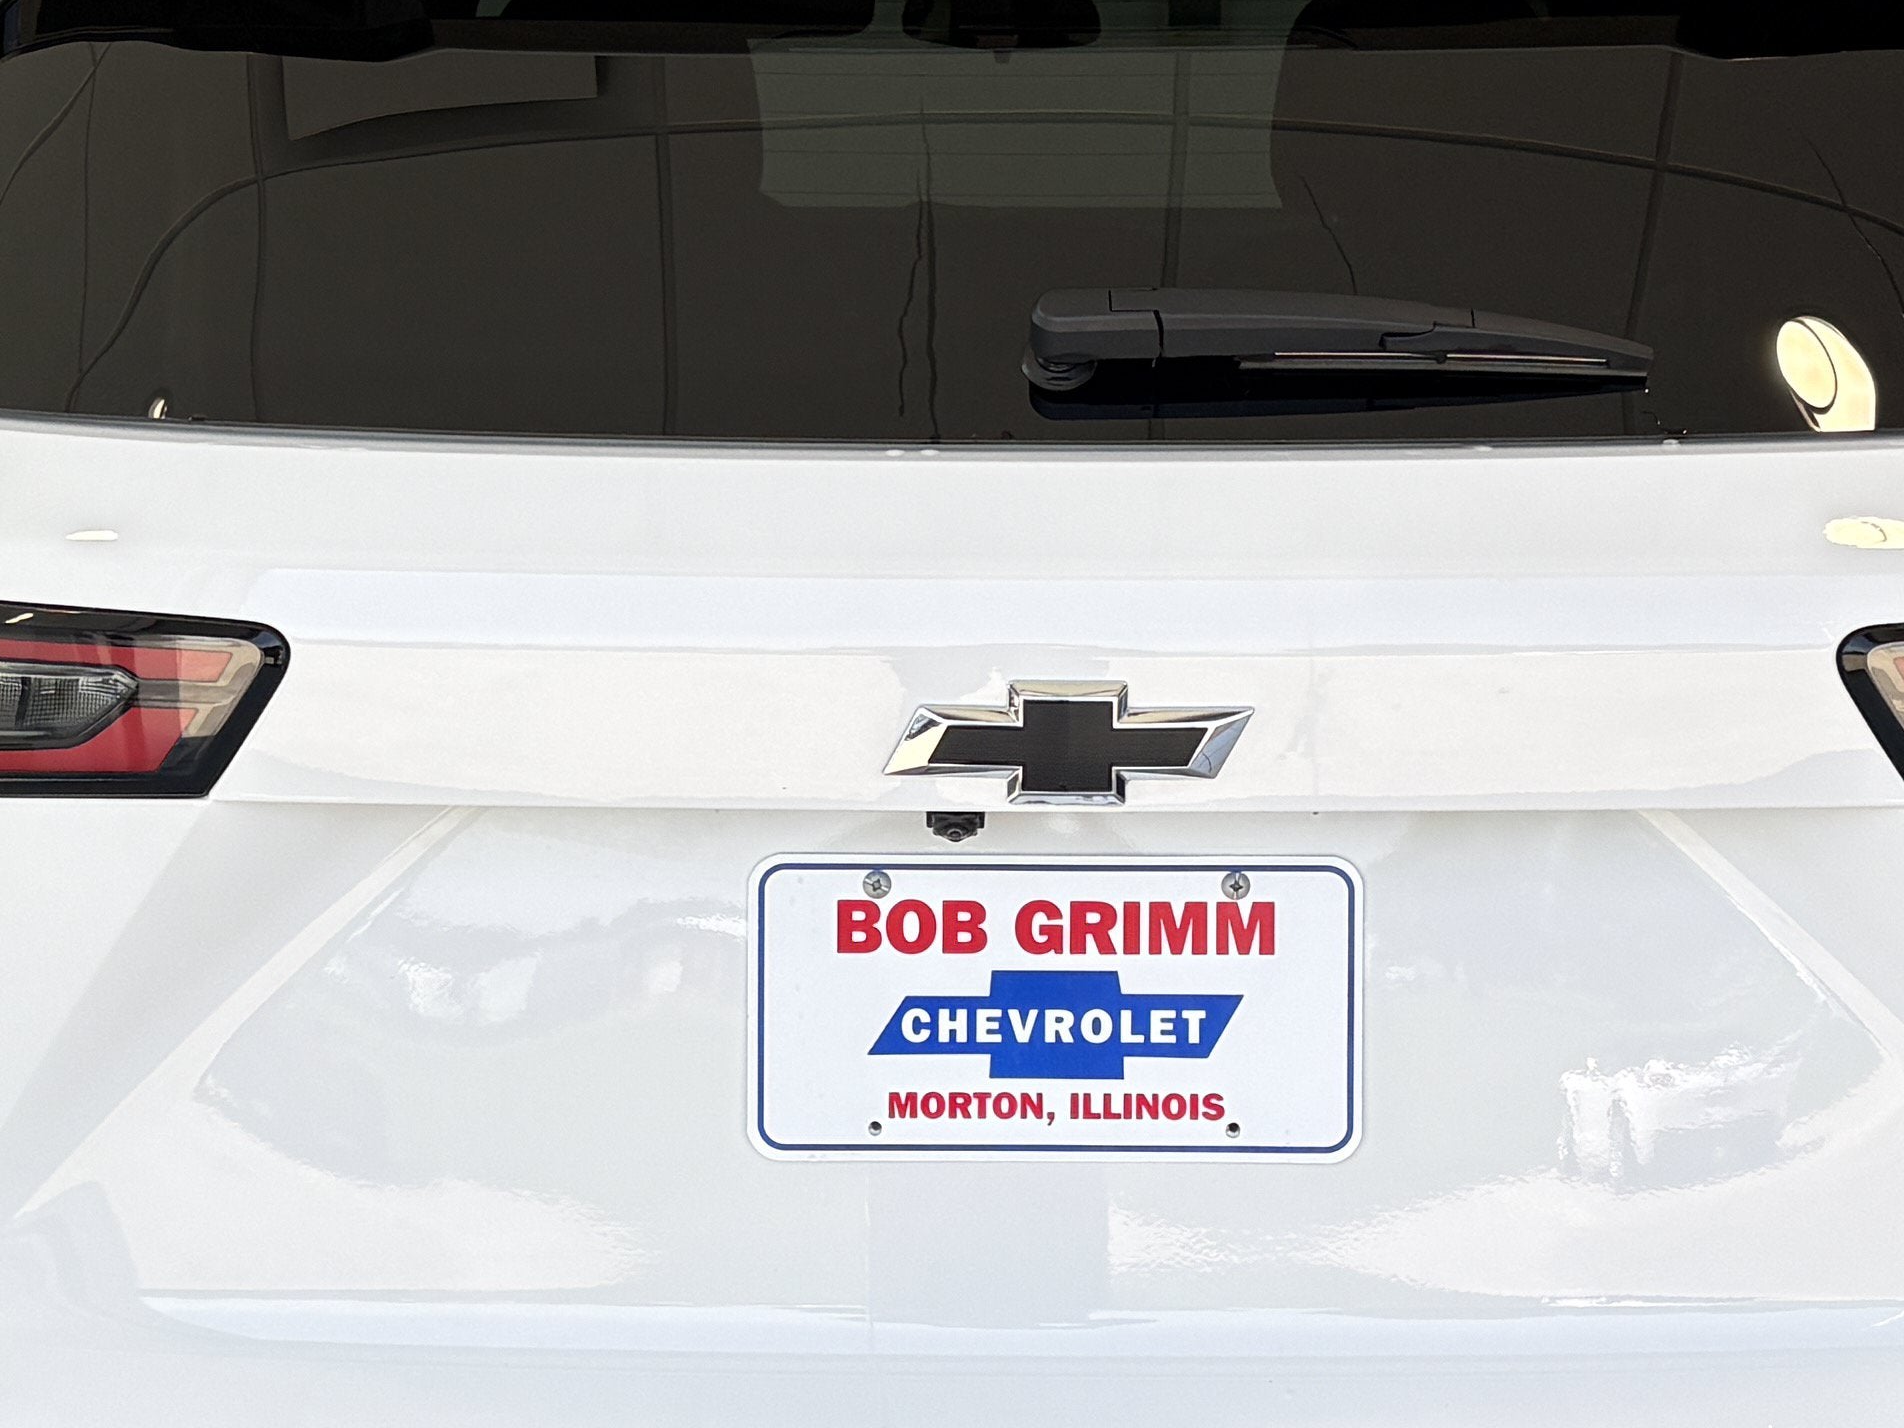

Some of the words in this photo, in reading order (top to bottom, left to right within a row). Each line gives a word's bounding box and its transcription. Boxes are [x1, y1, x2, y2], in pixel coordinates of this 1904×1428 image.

[837, 899, 988, 955] BOB
[1015, 900, 1277, 956] GRIMM
[901, 1007, 1207, 1045] CHEVROLET
[888, 1091, 1055, 1127] MORTON,
[1069, 1092, 1226, 1121] ILLINOIS
